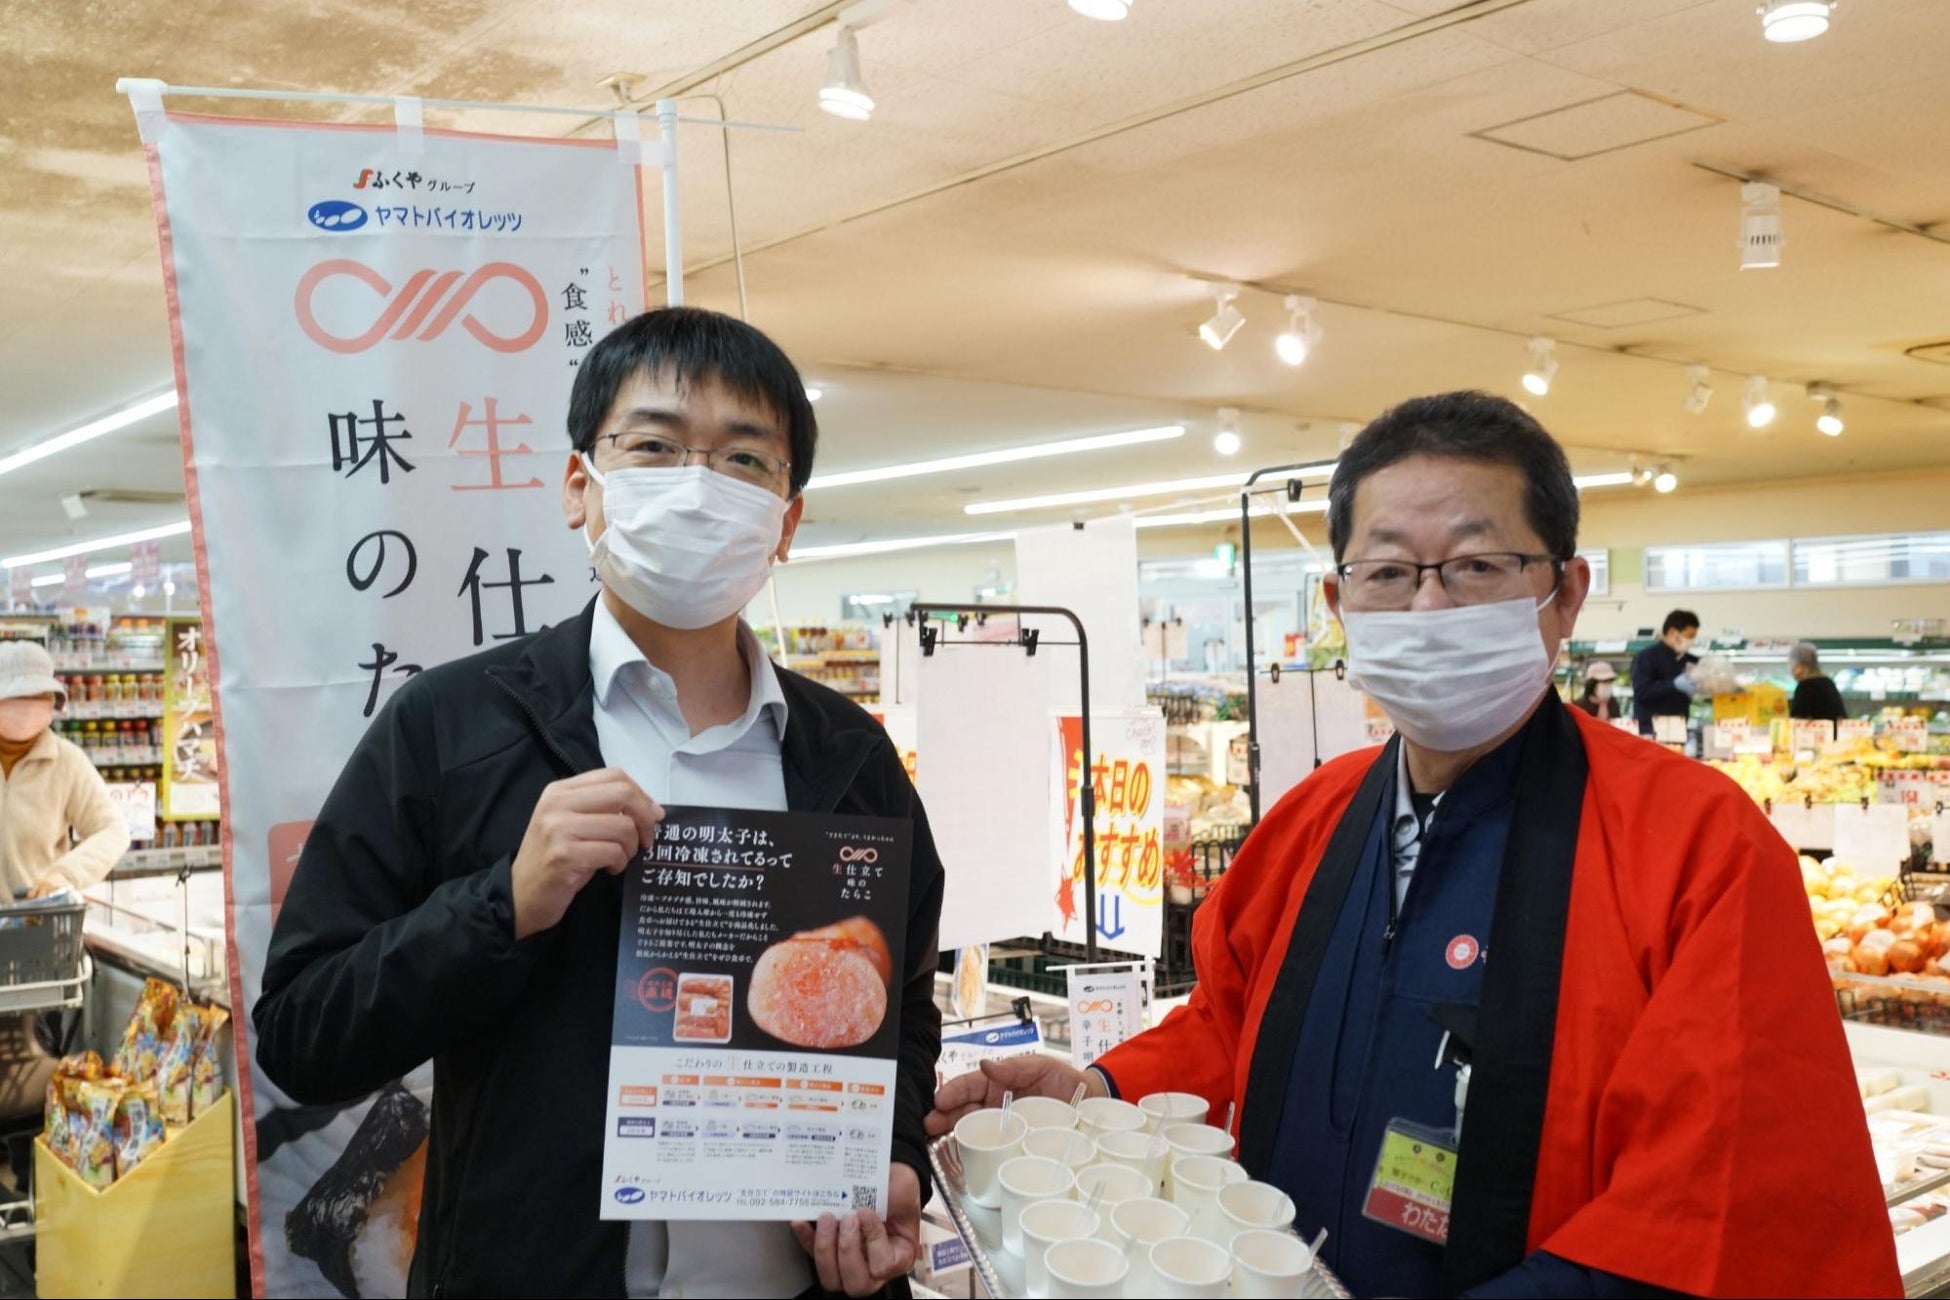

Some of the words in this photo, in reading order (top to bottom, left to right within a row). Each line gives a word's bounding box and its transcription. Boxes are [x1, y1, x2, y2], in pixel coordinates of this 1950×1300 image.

[372, 171, 423, 190] ふくや
[427, 179, 476, 194] グループ
[375, 205, 523, 233] ヤマトバイオレッツ
[1089, 752, 1151, 816] 本日の
